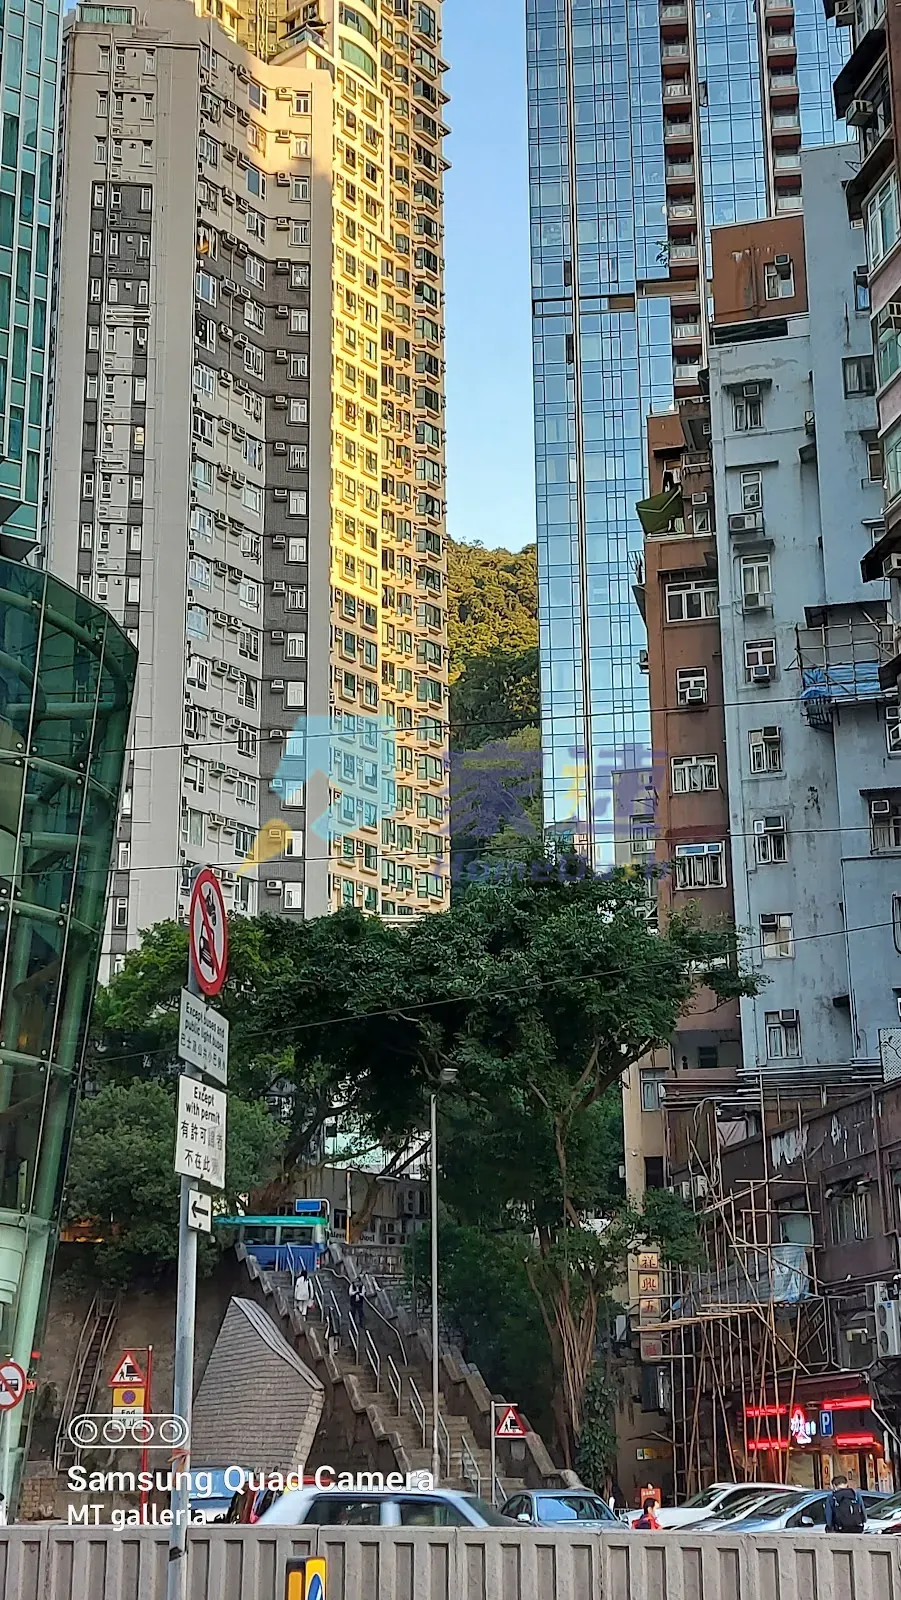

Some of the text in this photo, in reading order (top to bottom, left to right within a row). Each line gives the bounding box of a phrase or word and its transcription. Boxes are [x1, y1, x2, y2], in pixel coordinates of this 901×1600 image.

[185, 1001, 225, 1039] Except buses and
[184, 1018, 224, 1053] public light buses
[193, 1086, 215, 1108] Except
[185, 1101, 221, 1126] with permit
